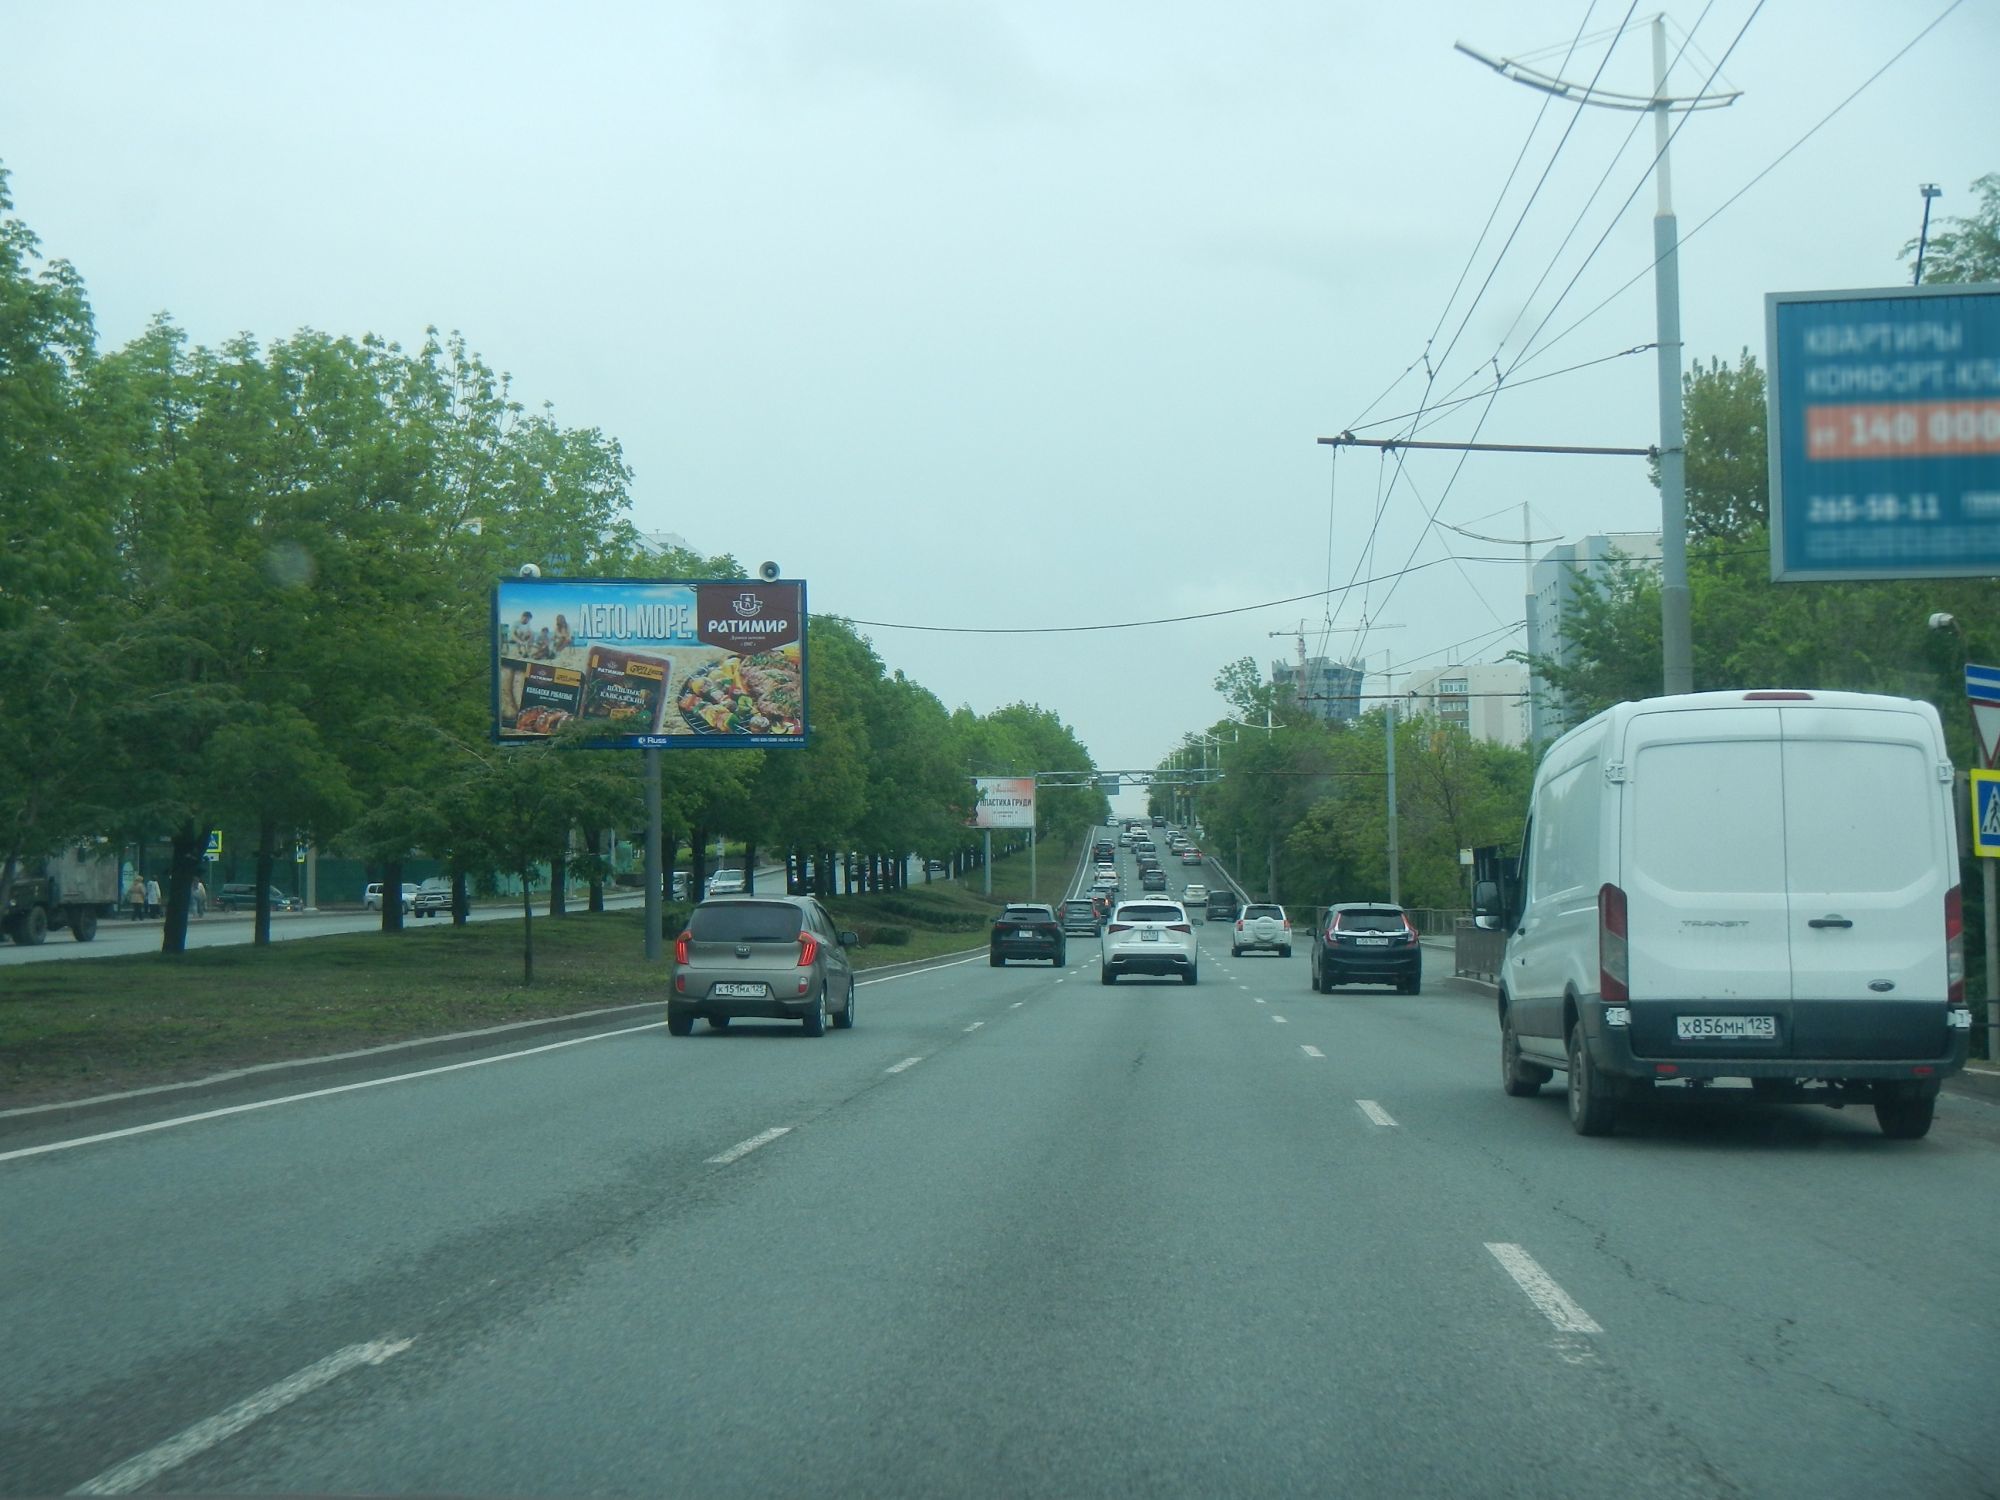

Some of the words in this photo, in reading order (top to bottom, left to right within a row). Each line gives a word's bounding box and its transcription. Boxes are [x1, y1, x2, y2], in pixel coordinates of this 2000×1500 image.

[1806, 323, 1961, 354] КВАРТИРЫ
[1848, 411, 1917, 447] 140
[579, 603, 631, 639] ЛЕТО.
[637, 603, 692, 639] МОРЕ.
[708, 619, 788, 633] РАТИМИР
